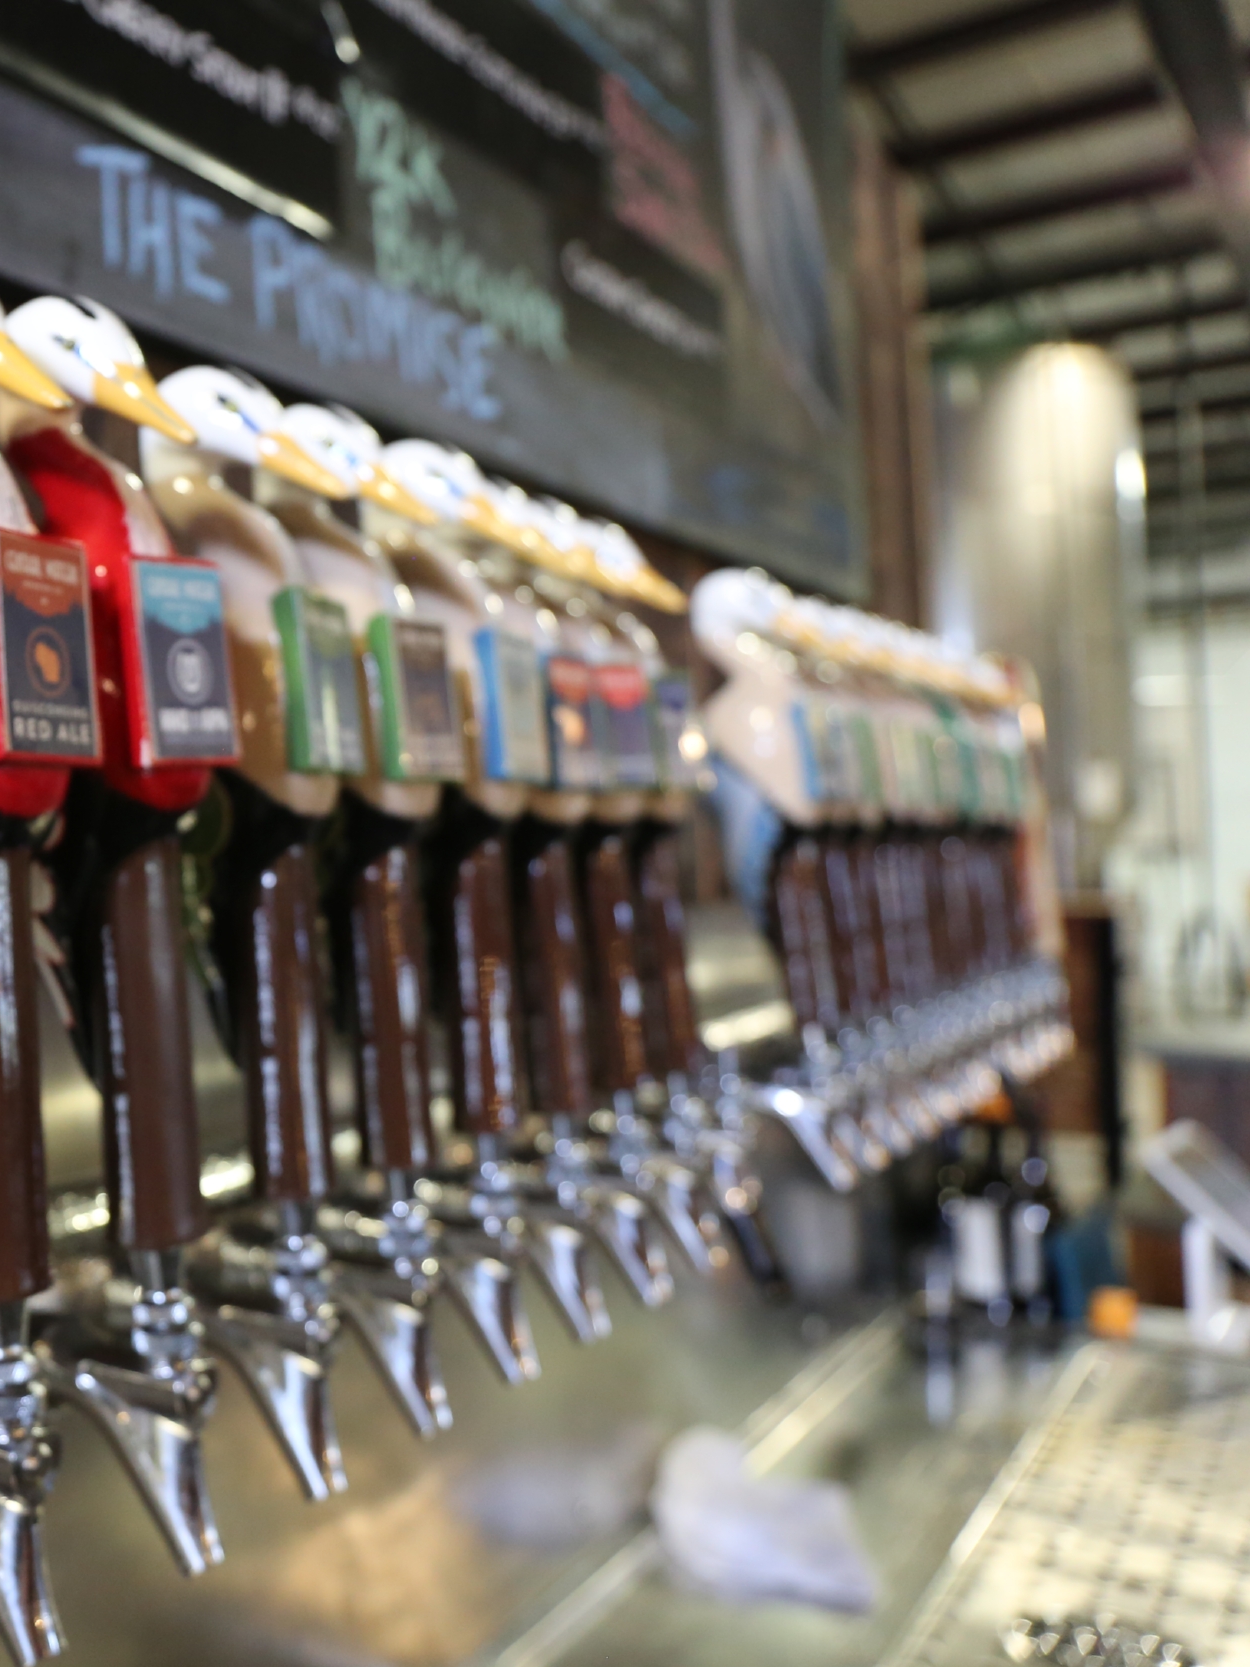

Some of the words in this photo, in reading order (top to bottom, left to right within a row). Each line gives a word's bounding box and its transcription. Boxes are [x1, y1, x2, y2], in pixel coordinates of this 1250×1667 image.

[76, 145, 231, 306] THE
[12, 715, 53, 742] RED
[55, 721, 91, 746] ALE
